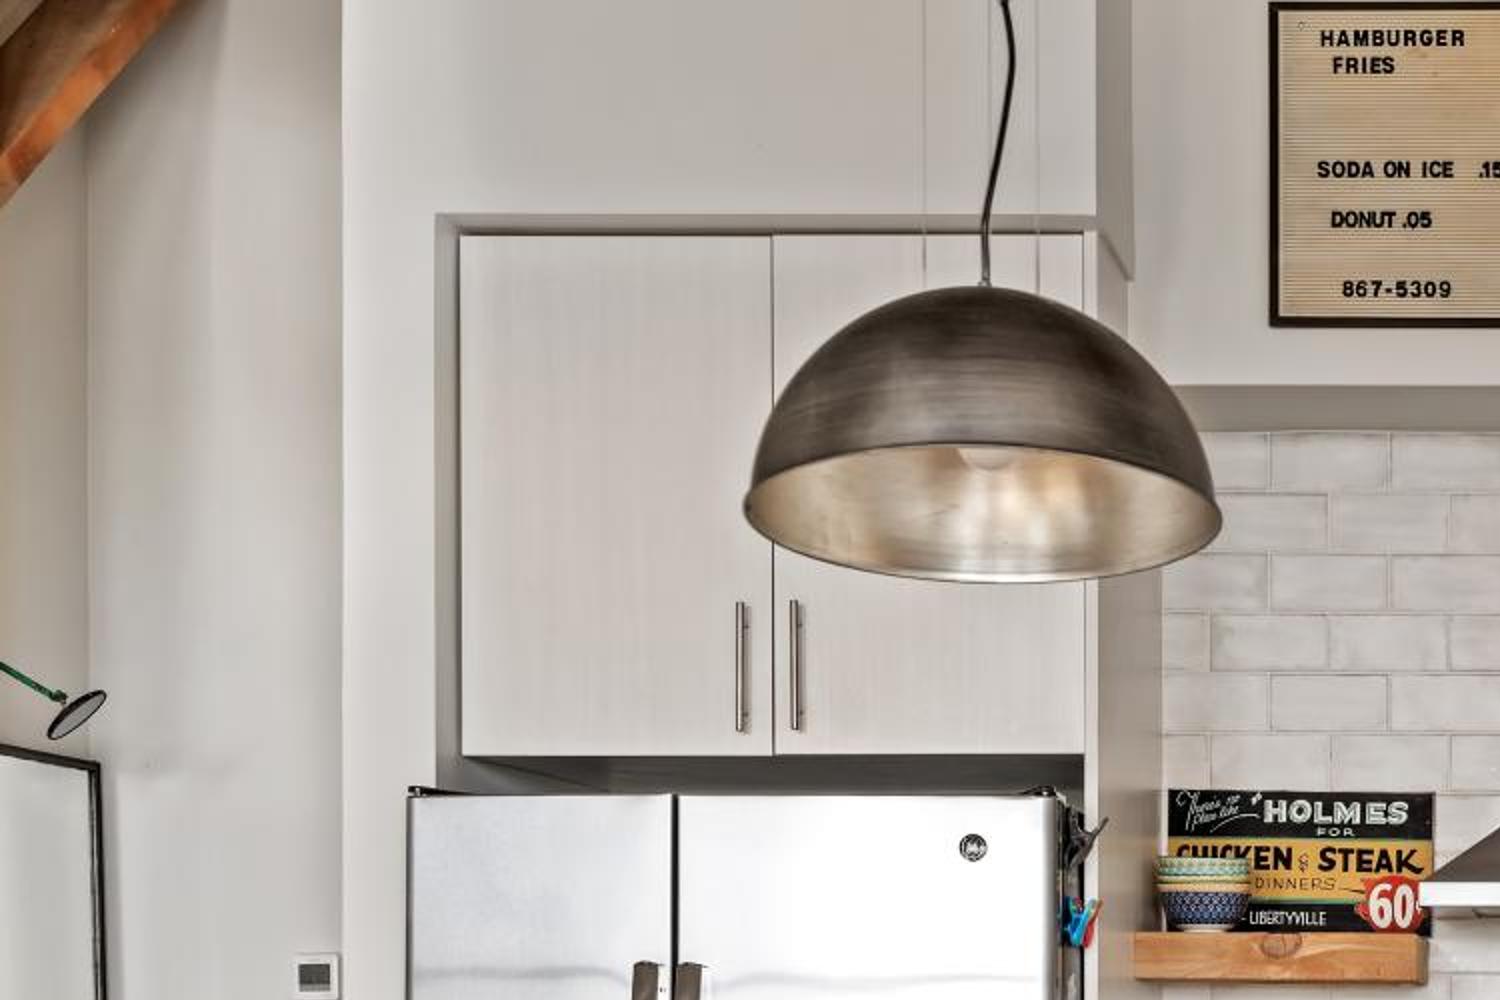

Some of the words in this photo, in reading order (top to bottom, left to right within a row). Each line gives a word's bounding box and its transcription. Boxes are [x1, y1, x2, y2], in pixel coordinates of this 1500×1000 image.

[1319, 28, 1466, 48] HAMBURGER
[1332, 56, 1396, 75] FRIES
[1317, 160, 1376, 179] SODA
[1382, 160, 1412, 179] ON
[1420, 160, 1455, 179] ICE
[1330, 209, 1397, 229] DONUT
[1401, 210, 1433, 230] .05
[1341, 280, 1453, 299] 867-5309
[1263, 799, 1409, 825] HOLMES
[1316, 827, 1355, 837] FOR
[1317, 845, 1425, 875] STEAK
[1255, 877, 1336, 891] DINNERS
